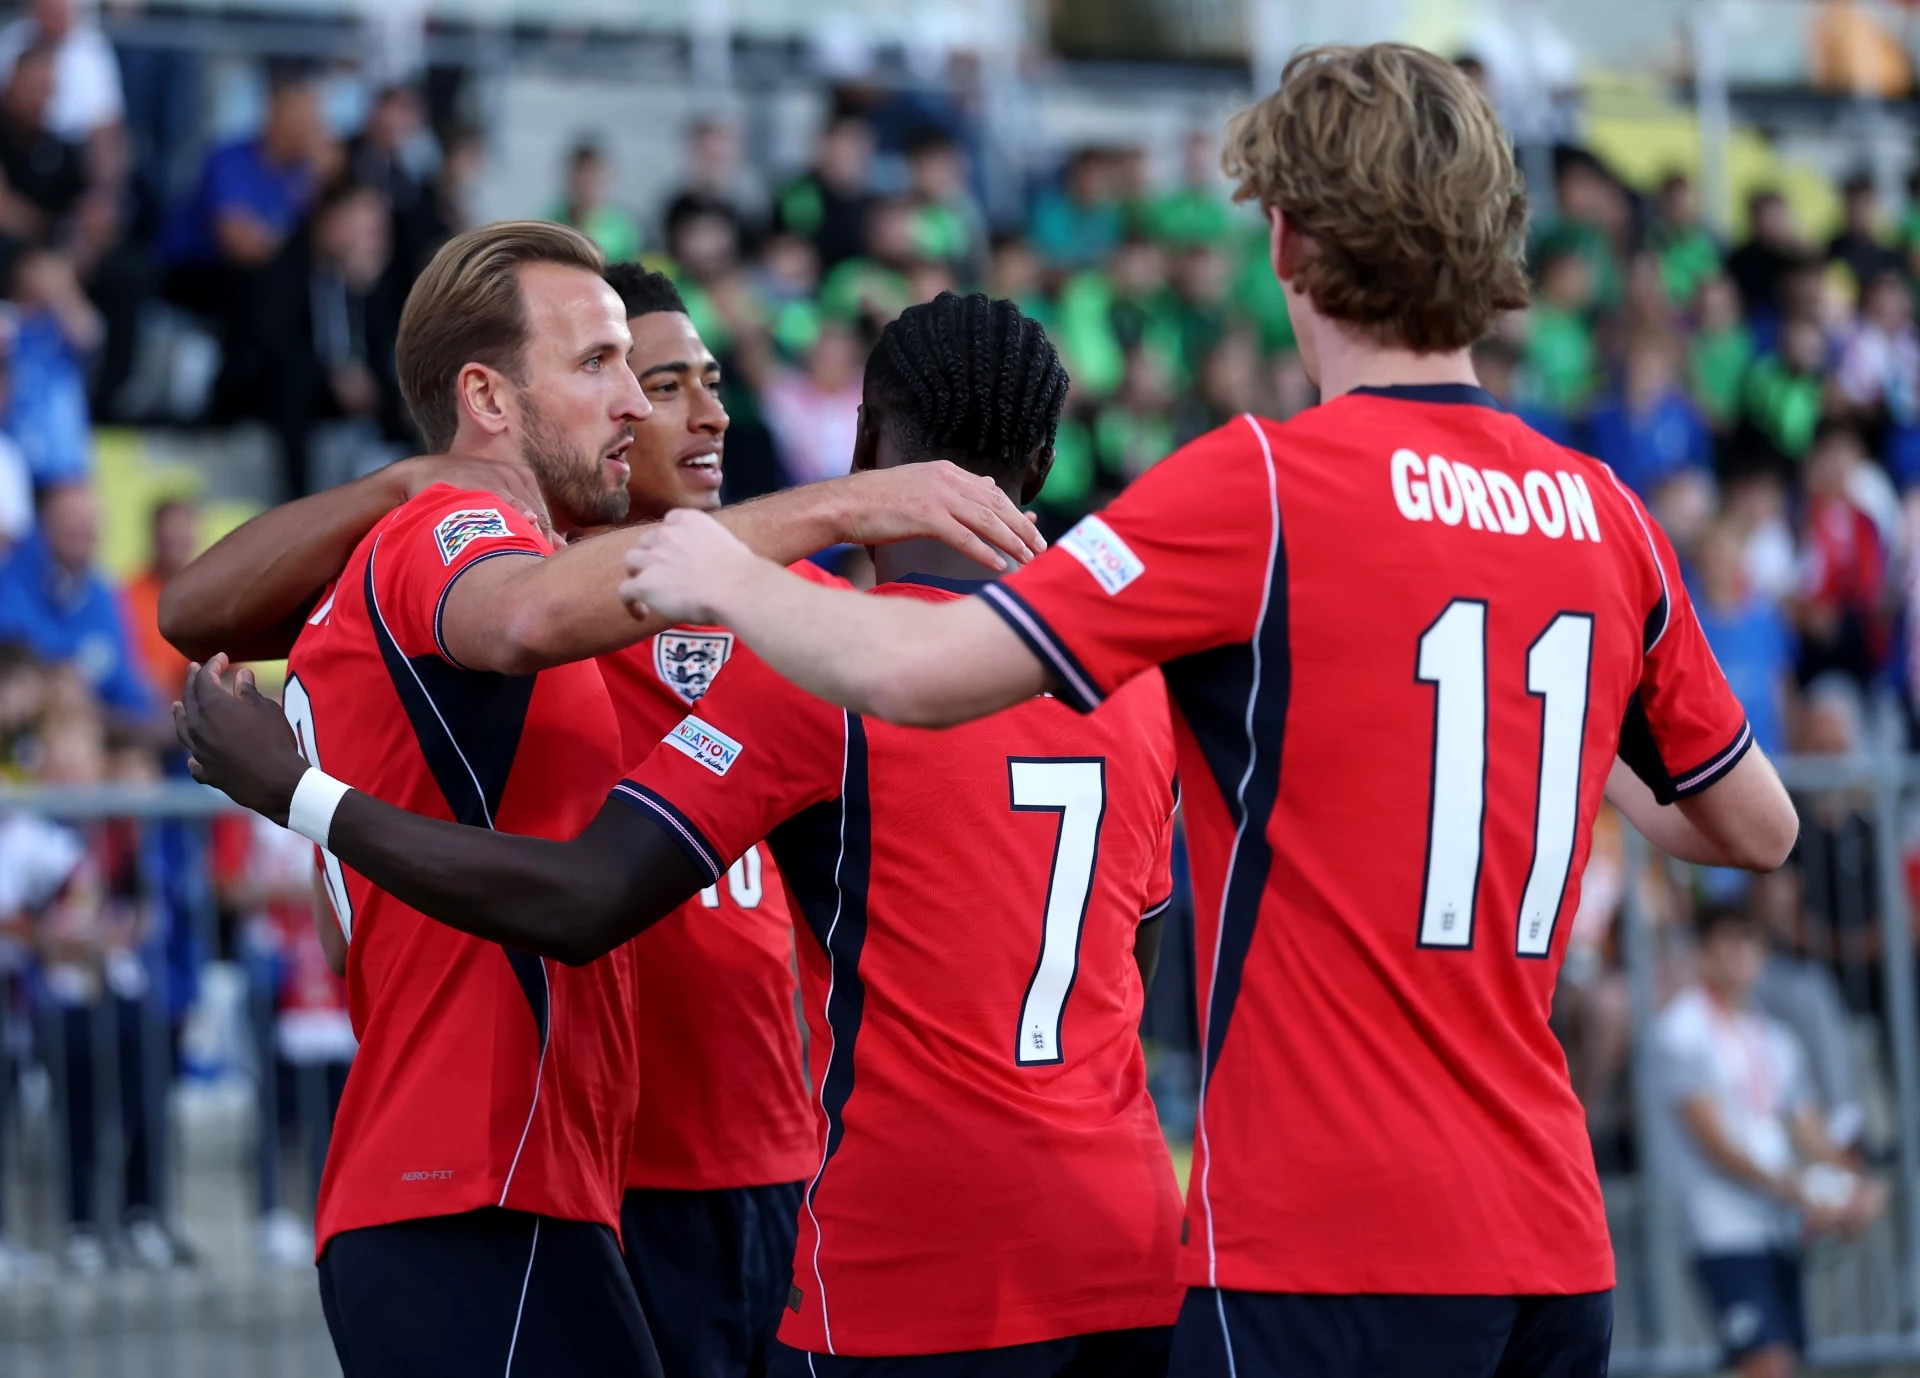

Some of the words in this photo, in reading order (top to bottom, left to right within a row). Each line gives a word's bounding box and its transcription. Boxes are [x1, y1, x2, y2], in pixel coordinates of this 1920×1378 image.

[1390, 448, 1602, 543] GORDON
[1414, 597, 1595, 959] 11
[699, 844, 763, 909] 0
[1006, 756, 1107, 1066] 7
[401, 1170, 454, 1181] AERO-FIT
